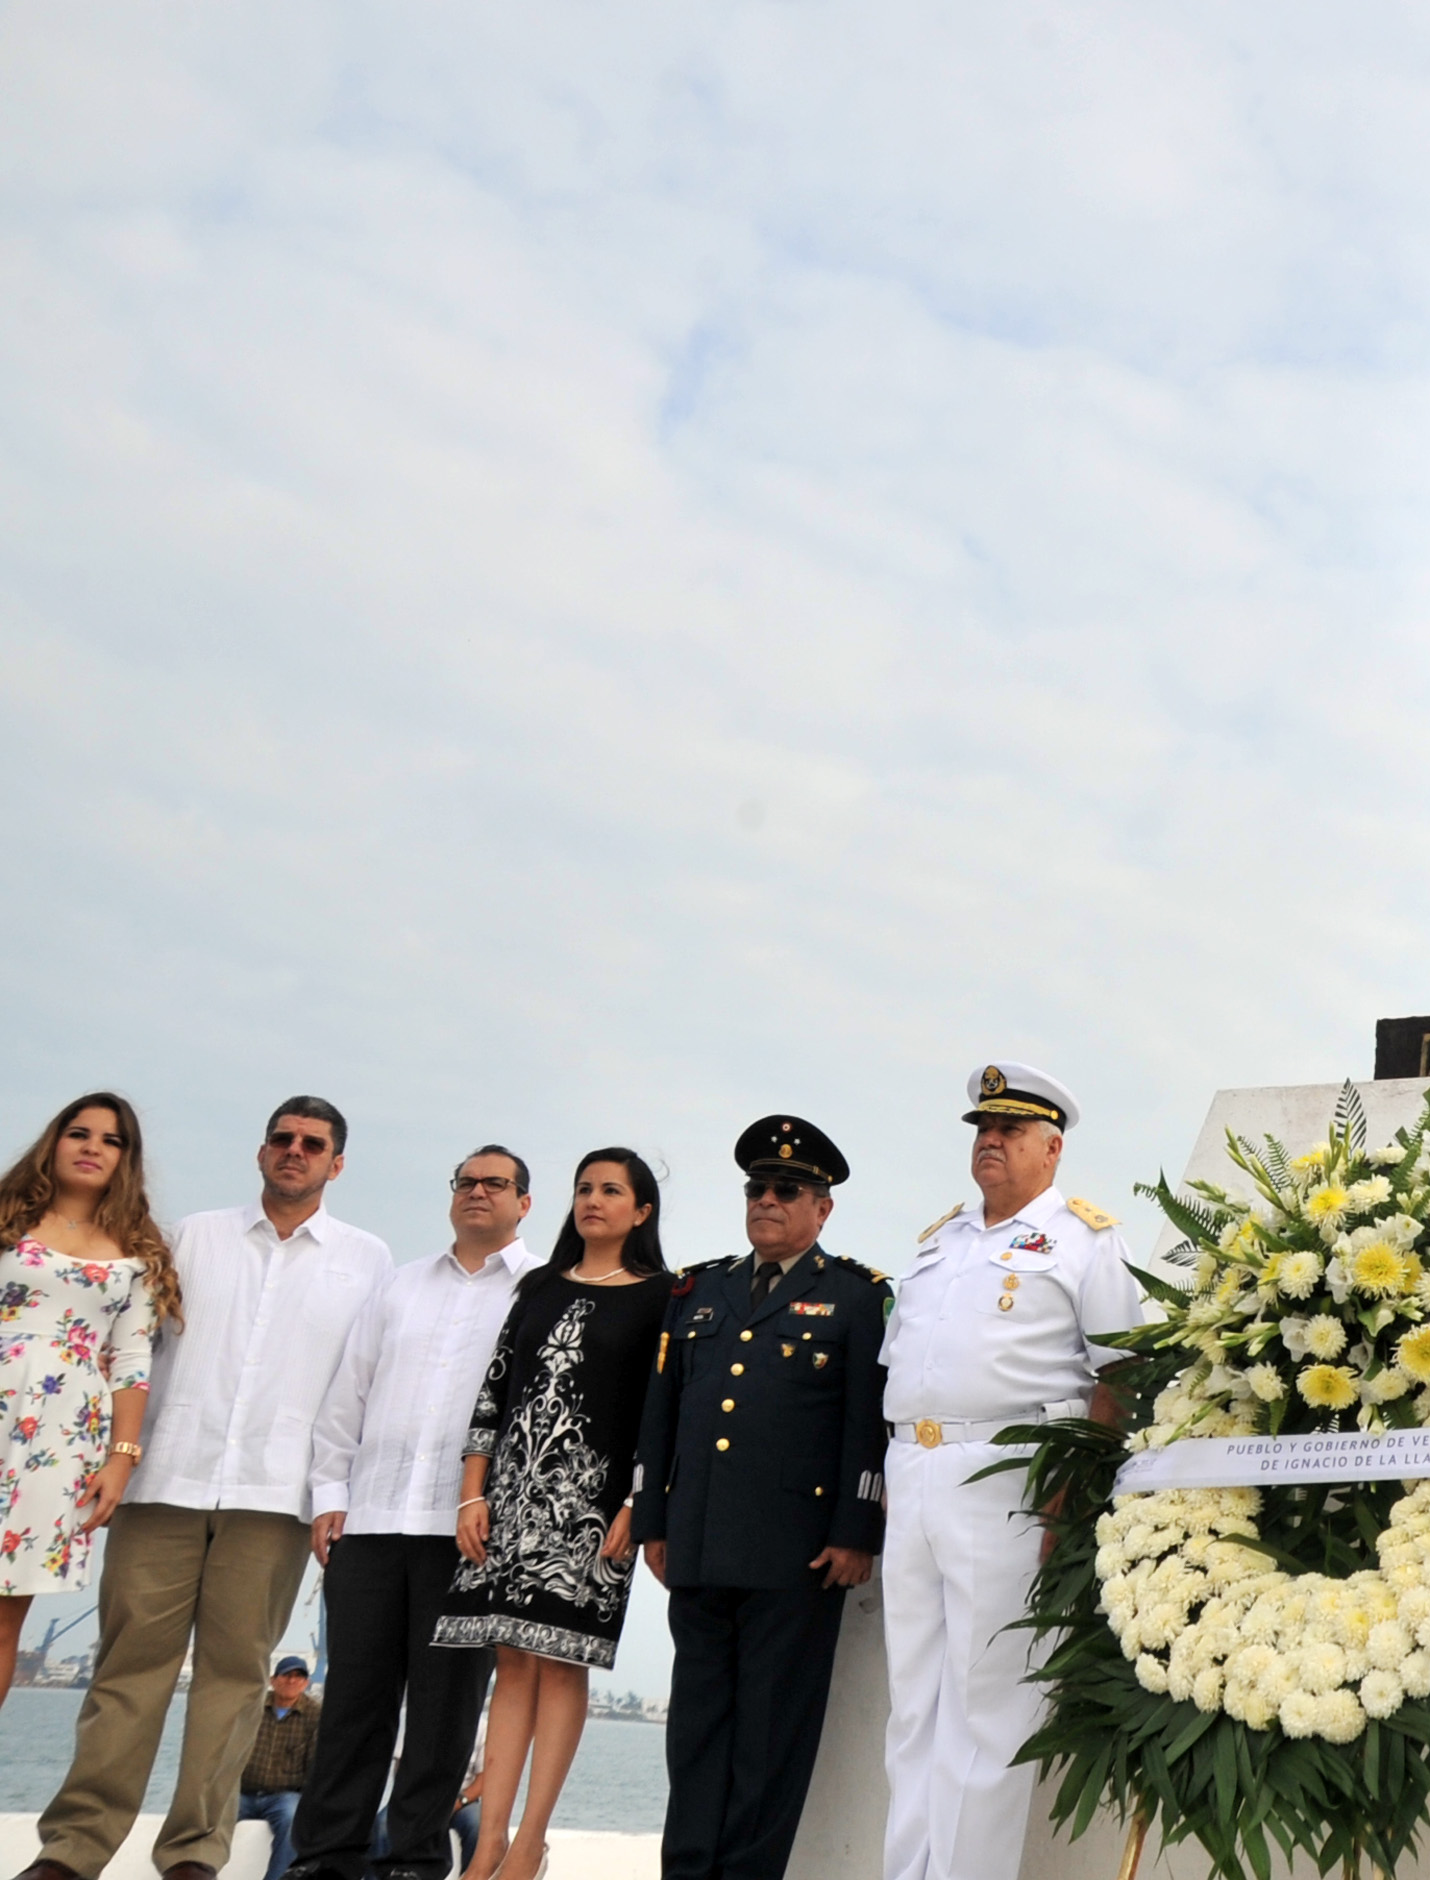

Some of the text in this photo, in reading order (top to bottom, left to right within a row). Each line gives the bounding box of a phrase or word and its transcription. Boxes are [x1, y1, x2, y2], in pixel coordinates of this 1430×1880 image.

[1227, 1443, 1283, 1455] PUEBLO
[1290, 1442, 1297, 1453] Y
[1303, 1438, 1381, 1453] GOBIERNO
[1387, 1436, 1405, 1449] DE
[1260, 1459, 1279, 1471] DE
[1284, 1456, 1348, 1470] IGNACIO
[1354, 1455, 1373, 1467] DE
[1379, 1454, 1397, 1466] LA
